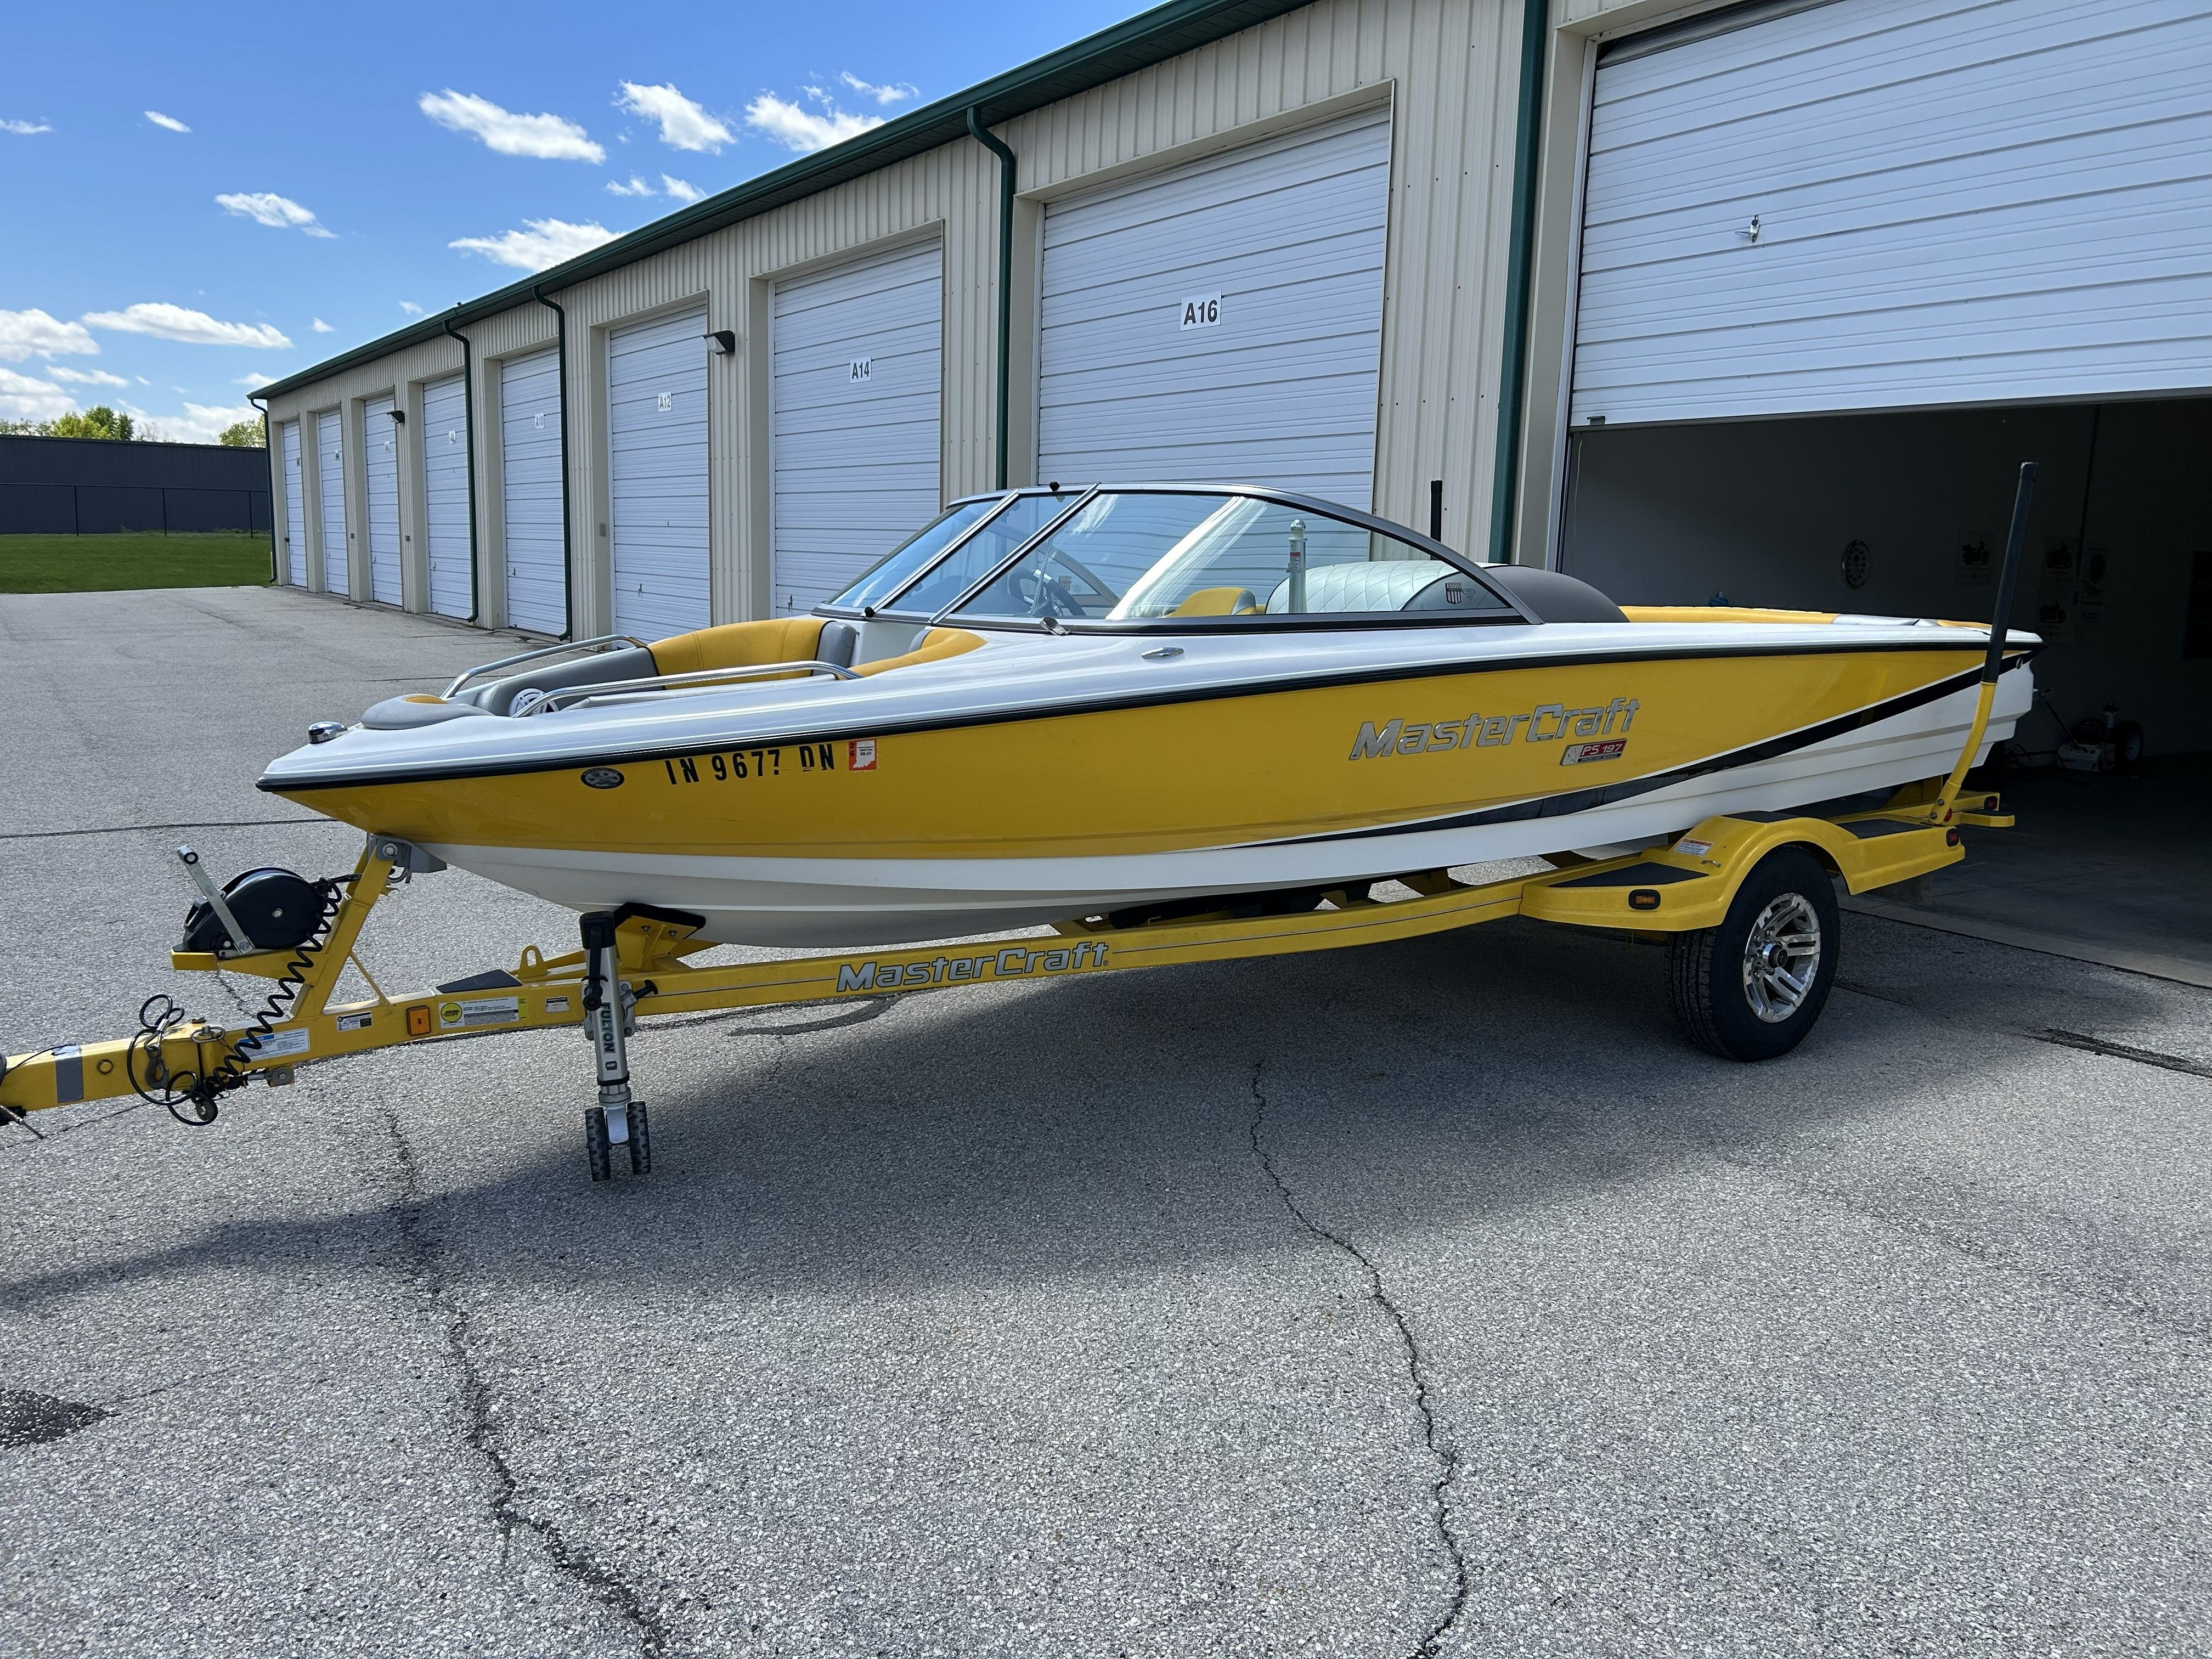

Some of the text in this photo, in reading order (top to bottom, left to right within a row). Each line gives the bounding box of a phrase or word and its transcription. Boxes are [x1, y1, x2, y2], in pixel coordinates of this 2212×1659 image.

[1183, 300, 1217, 325] A16
[851, 361, 870, 379] A14
[659, 394, 670, 409] A12
[1348, 697, 1641, 760] MasterCraft
[664, 743, 835, 785] IN 9677 DN
[1582, 743, 1623, 755] PS 197
[836, 941, 1109, 992] MasterCraft
[600, 1002, 616, 1053] FULTON
